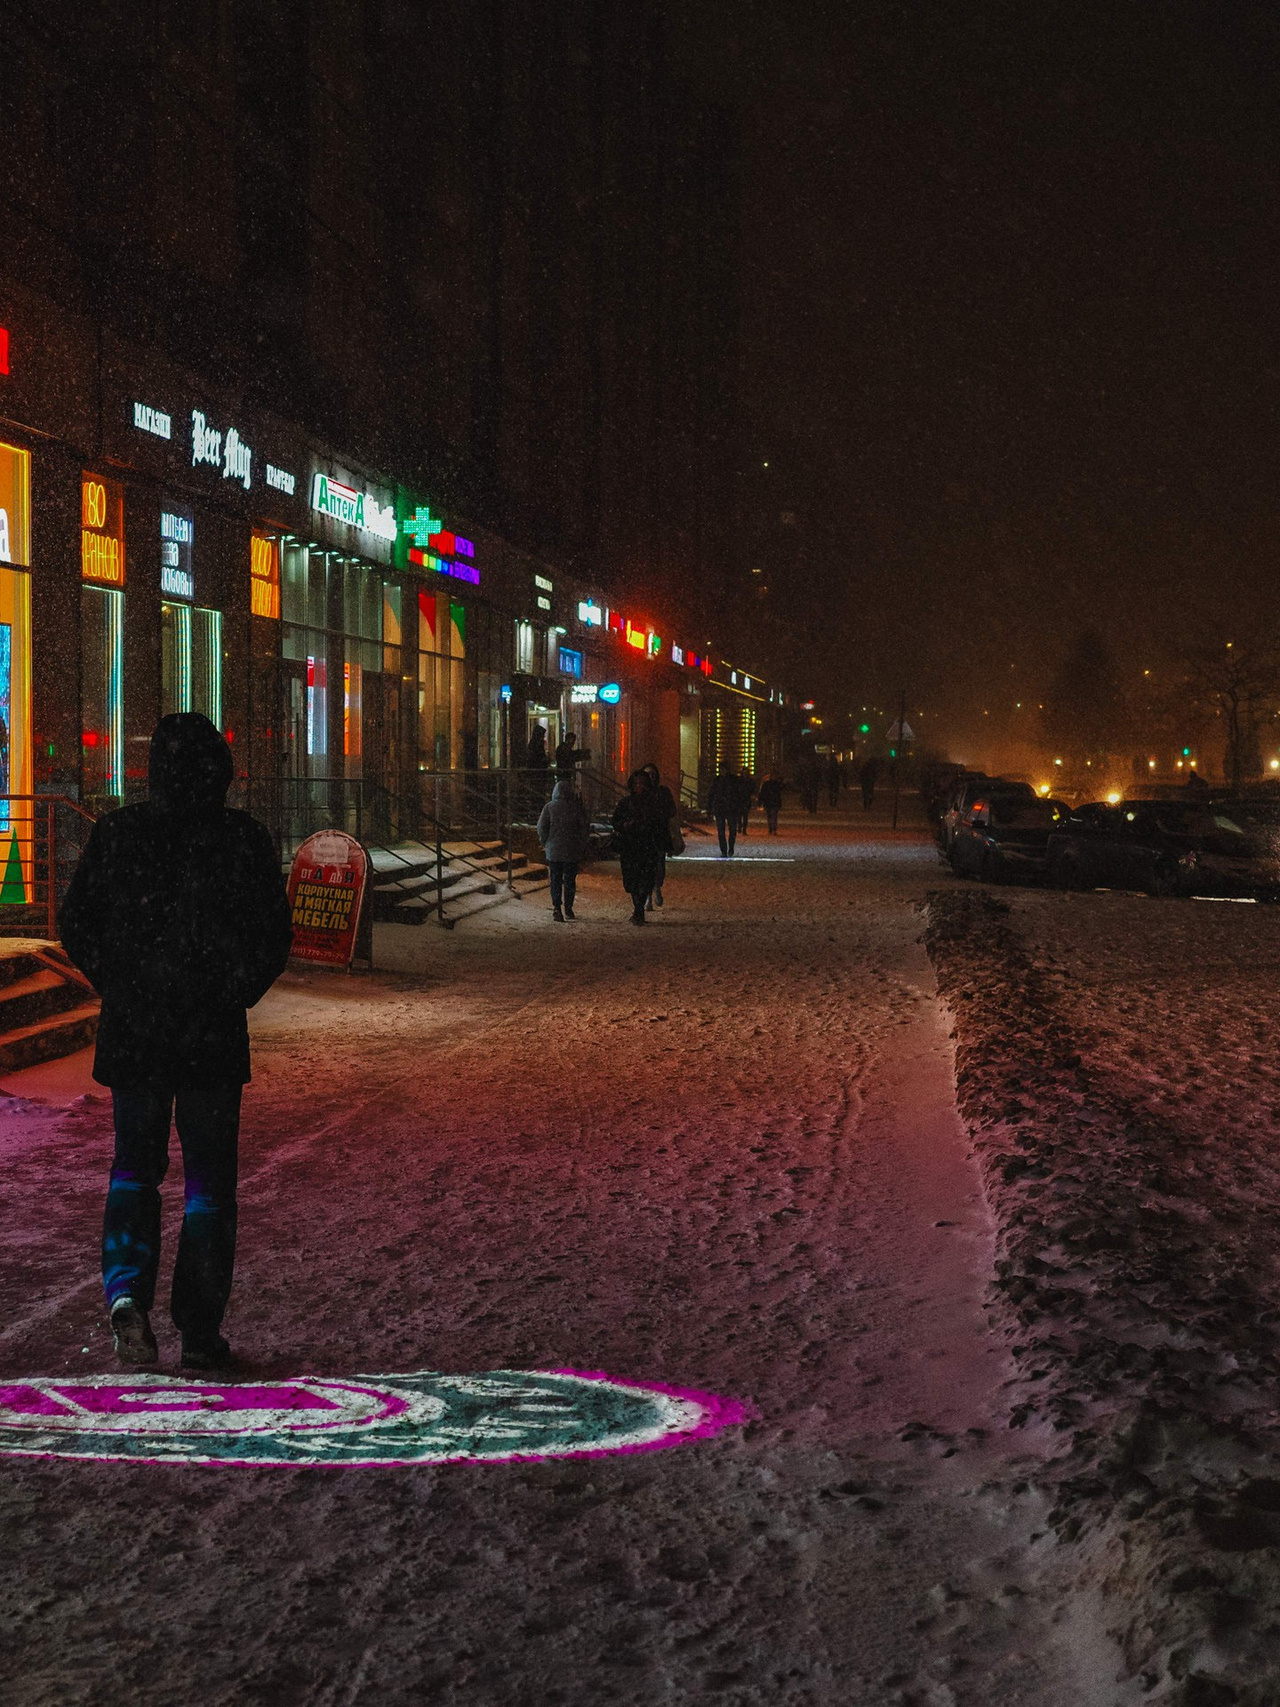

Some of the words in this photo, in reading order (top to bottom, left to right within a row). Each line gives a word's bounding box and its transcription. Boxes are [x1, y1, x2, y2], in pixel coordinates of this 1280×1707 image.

[301, 868, 312, 879] ОТ
[313, 867, 323, 880] А
[297, 883, 354, 901] КОРПУСНАЯ
[295, 895, 302, 908] И
[305, 897, 352, 914] МЯГКАЯ
[292, 909, 349, 930] МЕБЕЛЬ
